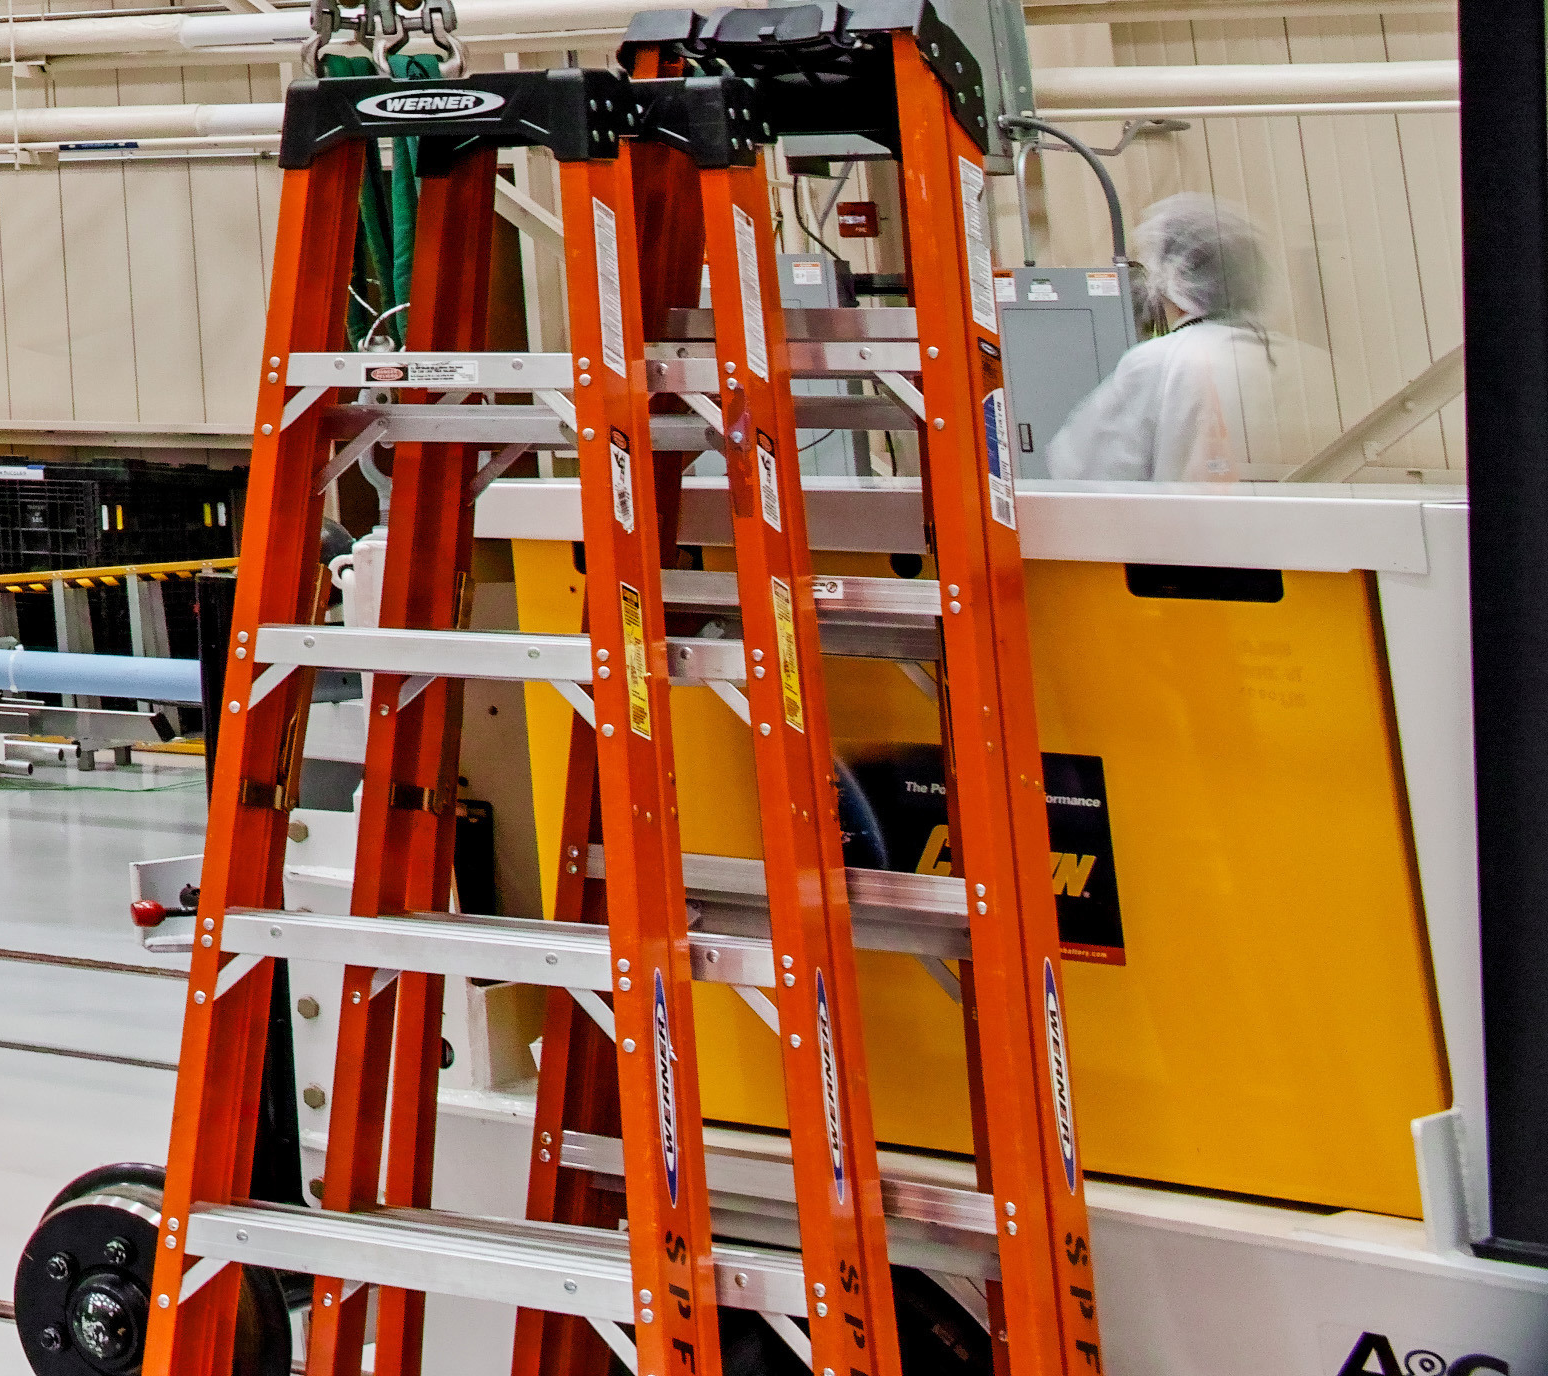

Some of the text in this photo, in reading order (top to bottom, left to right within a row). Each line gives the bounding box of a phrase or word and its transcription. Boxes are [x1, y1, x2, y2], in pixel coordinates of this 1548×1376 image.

[386, 96, 476, 112] WERNER
[906, 781, 928, 794] The
[1045, 795, 1102, 808] ormance
[1060, 950, 1108, 959] battery.com
[657, 1016, 674, 1154] WERNER
[818, 1014, 840, 1151] WERNER
[1048, 1008, 1071, 1147] WERNER
